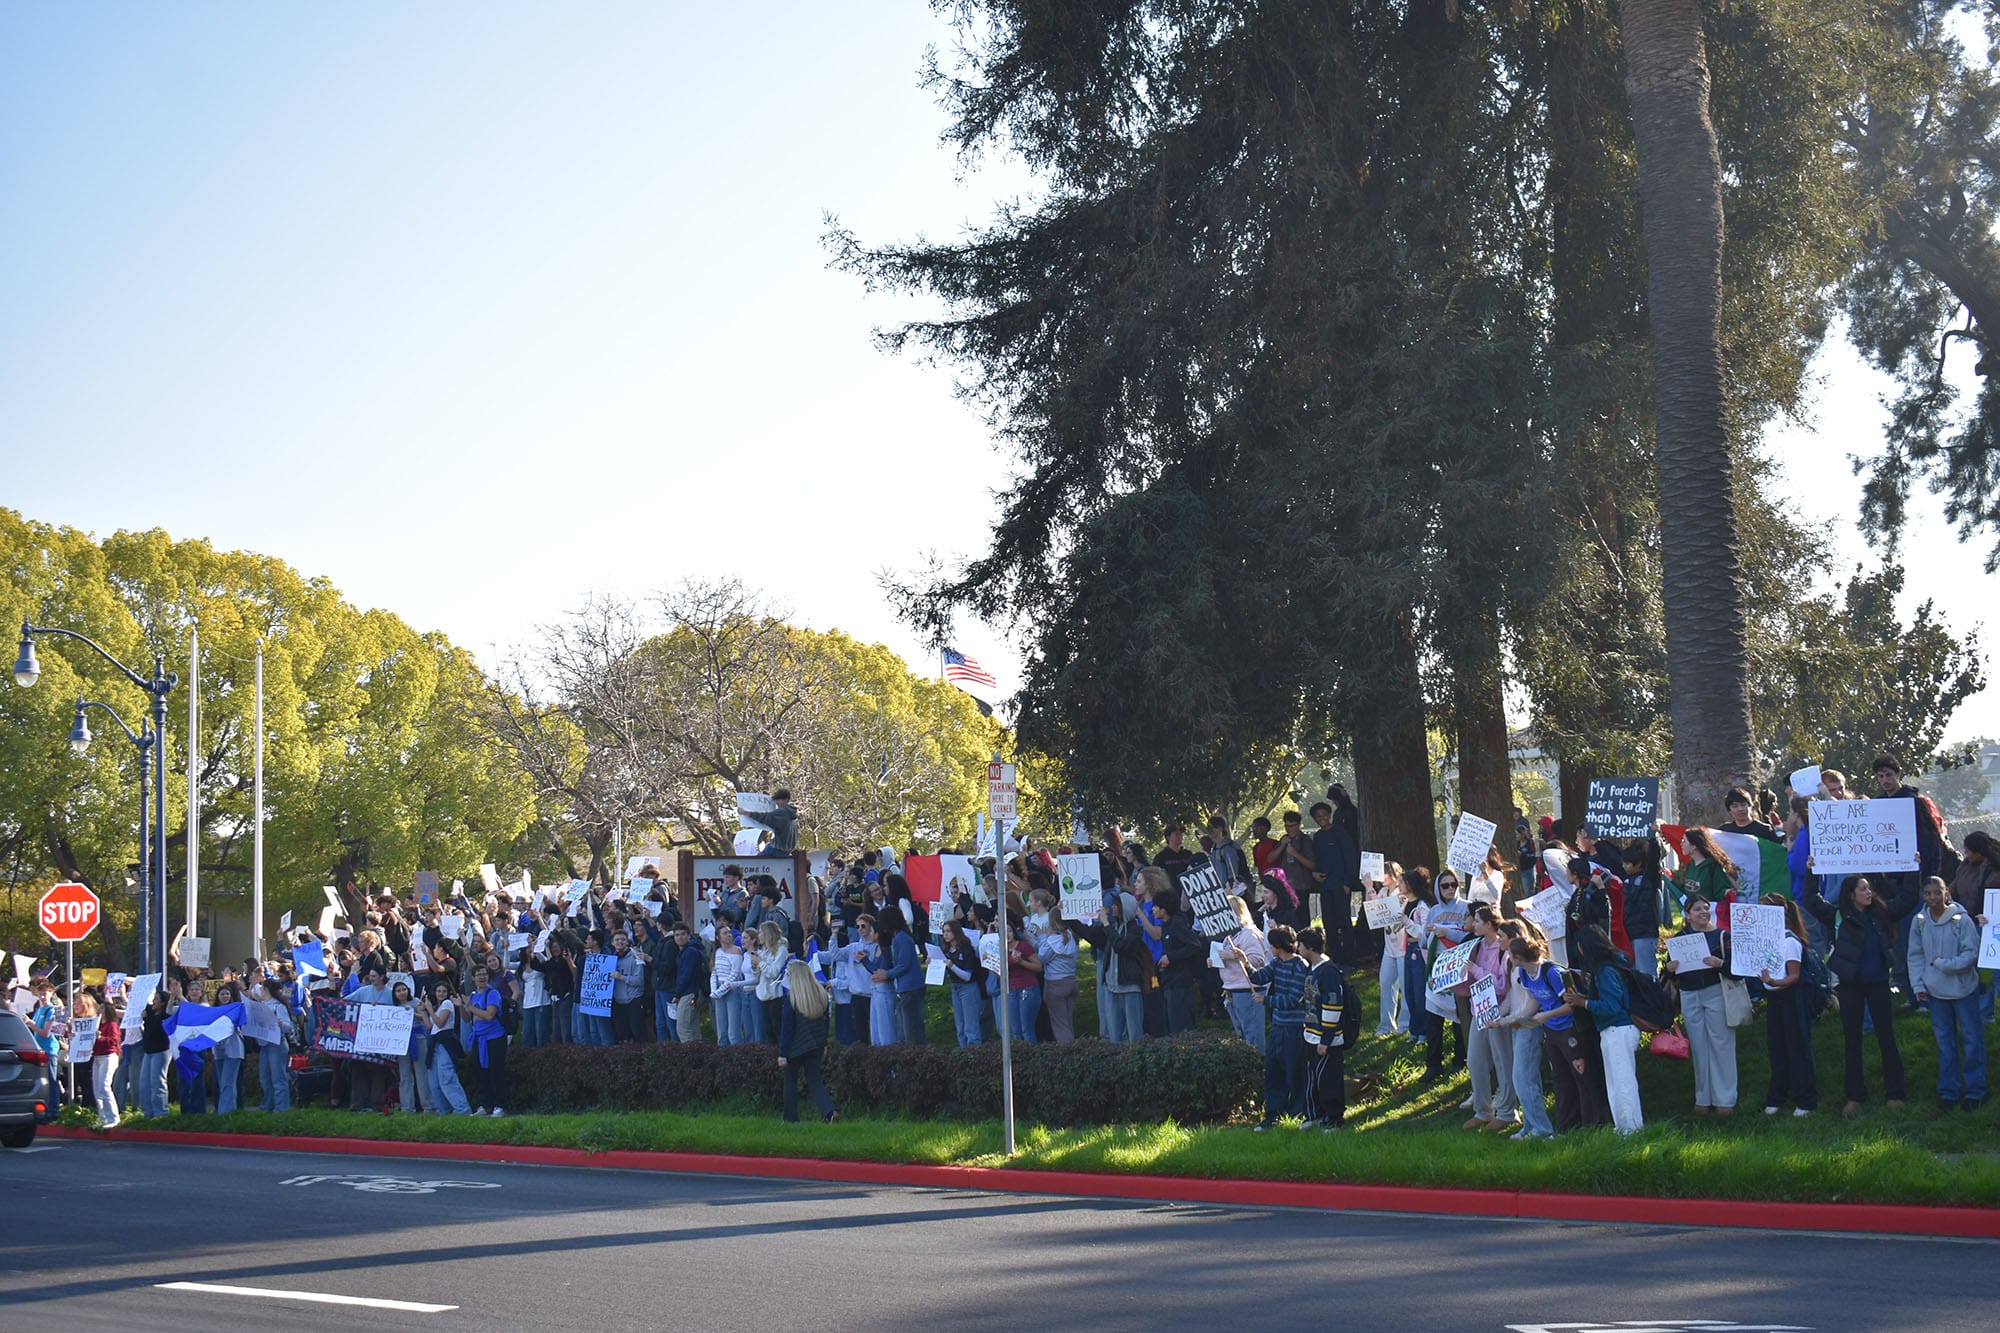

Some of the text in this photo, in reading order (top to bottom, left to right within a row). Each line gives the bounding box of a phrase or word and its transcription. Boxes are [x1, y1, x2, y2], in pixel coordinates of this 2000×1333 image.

[990, 765, 1000, 778] NO
[990, 782, 1015, 792] PARKING
[1590, 781, 1605, 798] My
[992, 795, 1013, 803] HERE TO
[1588, 798, 1653, 814] work harder
[994, 805, 1012, 813] CORNER
[1812, 803, 1868, 821] WE ARE
[1585, 811, 1642, 826] than your
[1815, 822, 1896, 836] SKIPPING OUR
[1812, 835, 1873, 845] LESSONS TO
[1813, 838, 1899, 857] TEACH YOU ONE!
[1059, 857, 1088, 875] NOT
[1180, 866, 1217, 896] DON'T
[1189, 888, 1228, 916] REPEAT
[43, 901, 96, 923] STOP
[1200, 909, 1239, 937] HISTORY
[1671, 935, 1705, 949] ABOLISH
[1684, 950, 1701, 962] ICE
[1435, 965, 1446, 977] MY
[1447, 960, 1457, 972] ICE
[588, 982, 610, 991] EXPECT
[1433, 970, 1459, 990] SHAVED
[1471, 976, 1494, 996] I PREFER
[1476, 996, 1492, 1014] ICE
[366, 1009, 376, 1022] I
[380, 1008, 404, 1020] LIKE
[360, 1023, 373, 1032] MY
[375, 1022, 410, 1032] HORCHATA
